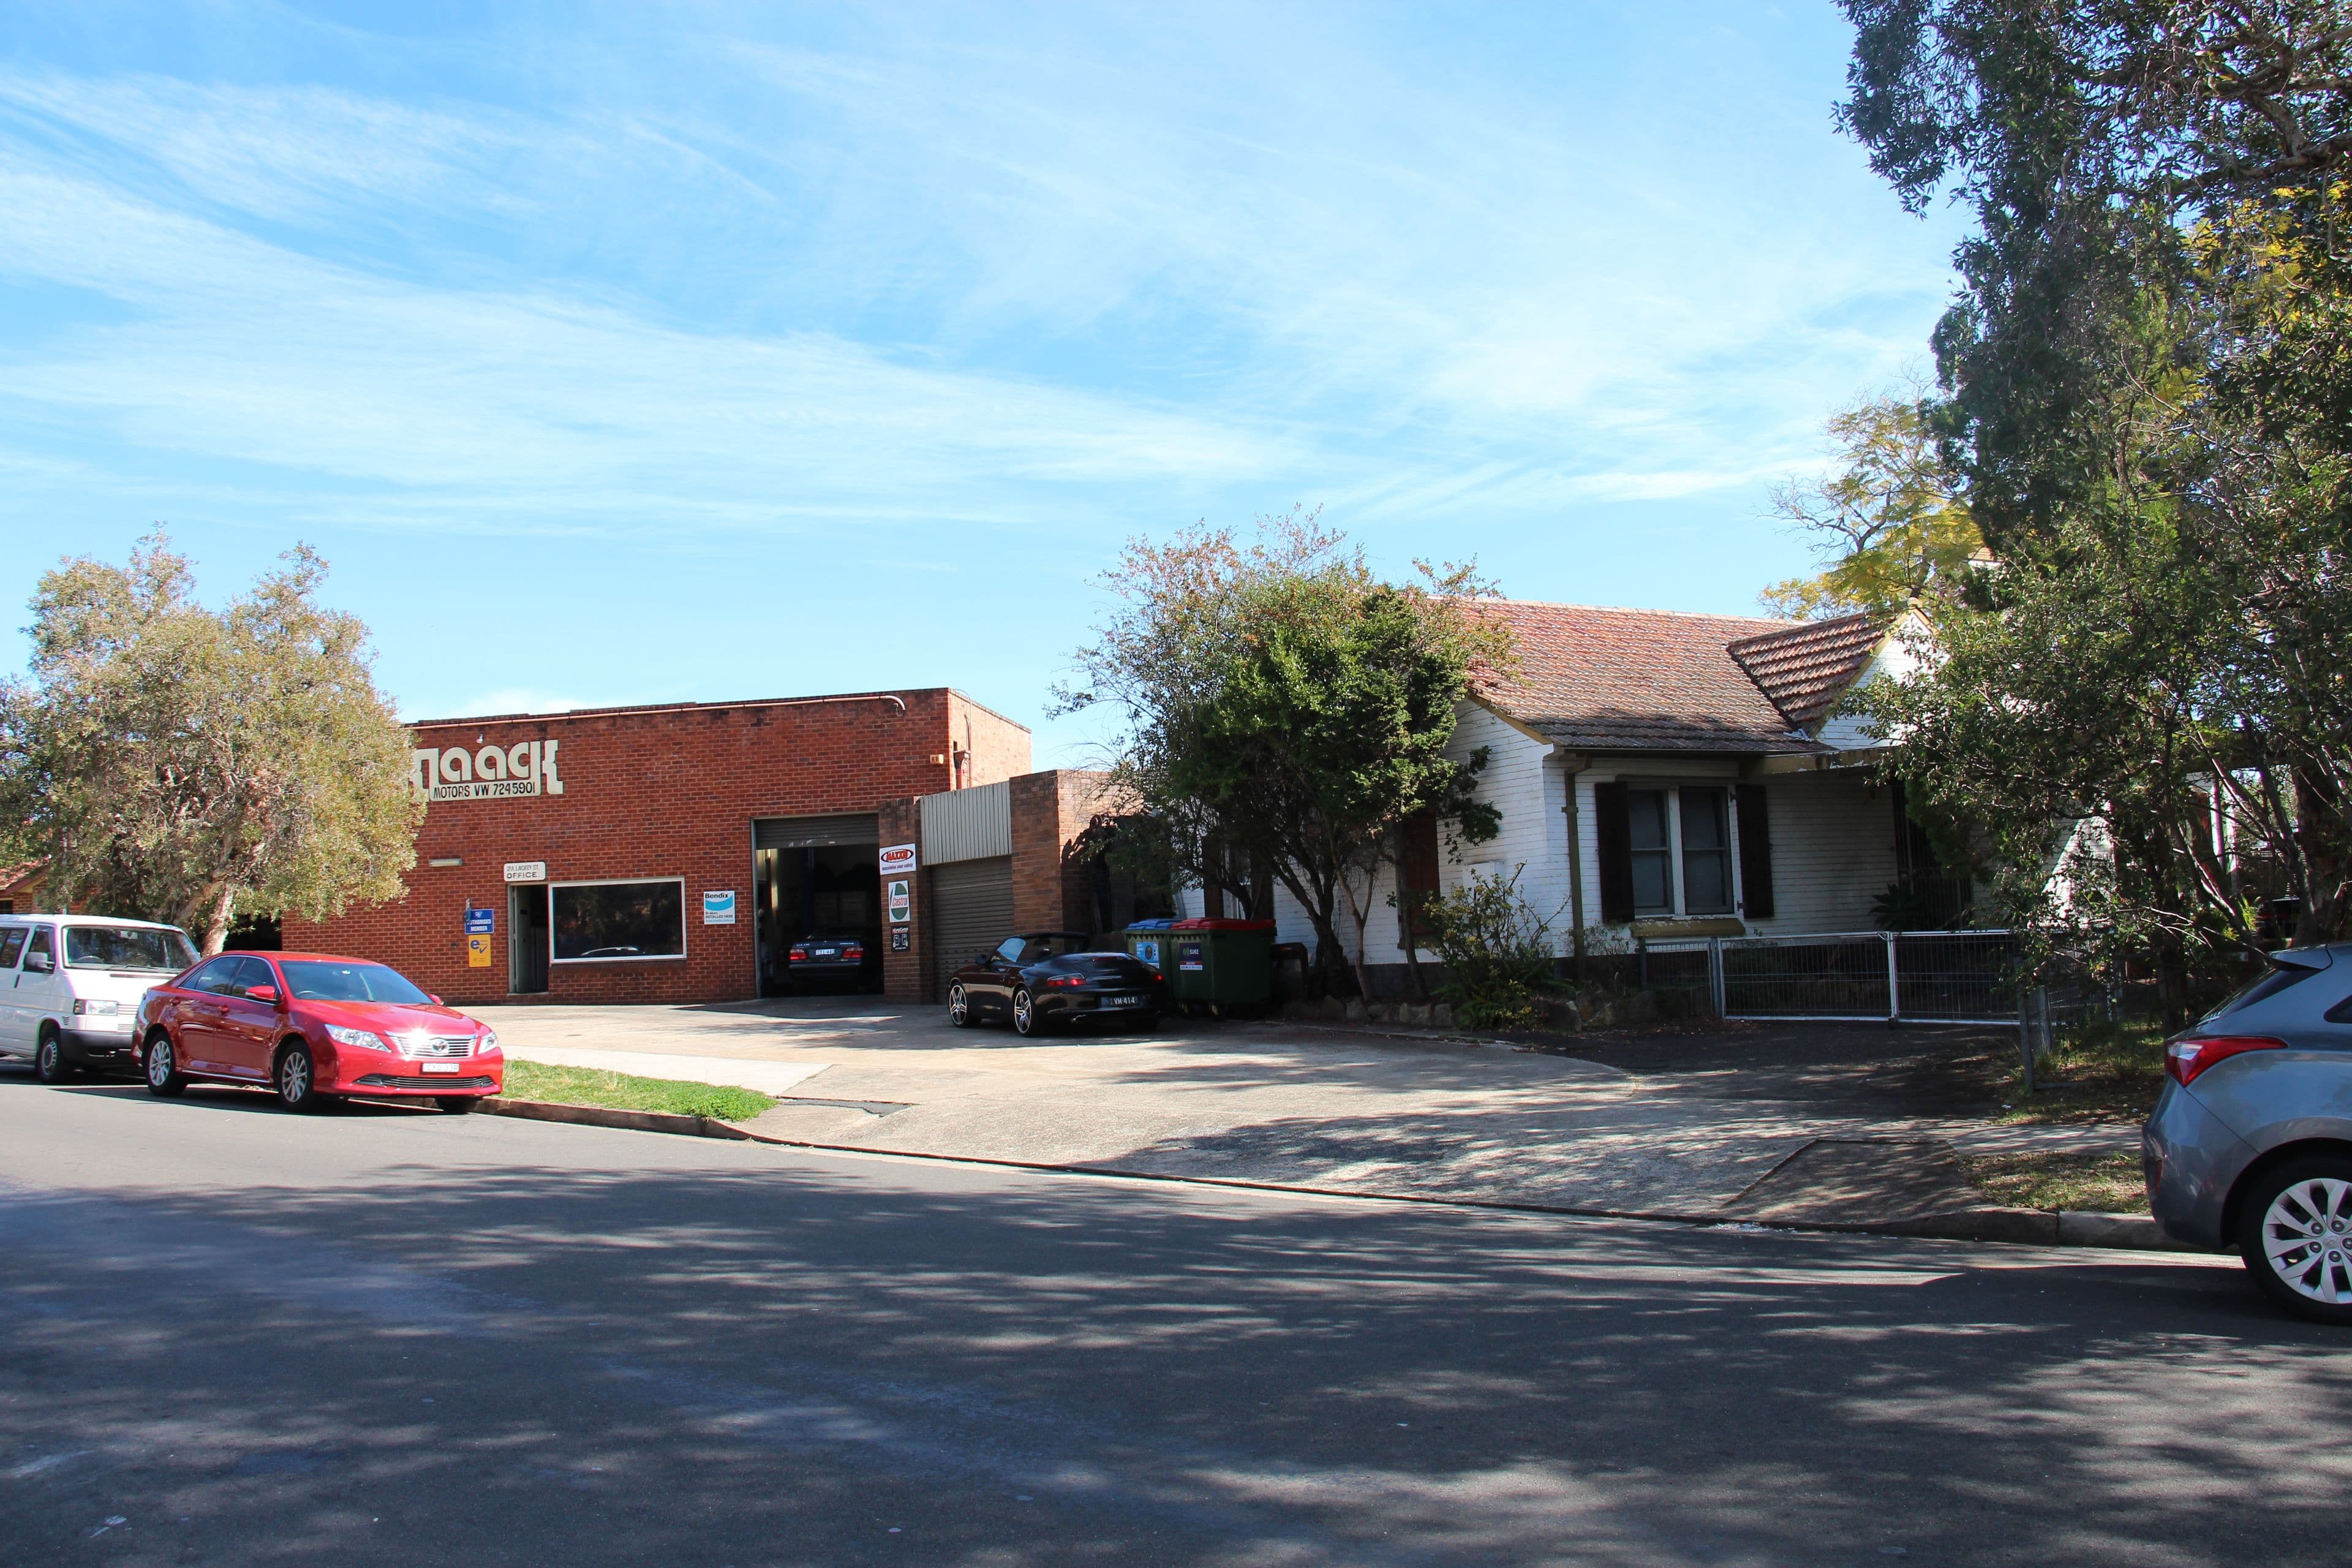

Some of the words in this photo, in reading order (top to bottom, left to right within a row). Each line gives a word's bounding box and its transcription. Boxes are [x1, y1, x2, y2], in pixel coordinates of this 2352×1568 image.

[433, 786, 470, 799] MOTORS
[474, 785, 489, 796] VW
[892, 896, 908, 907] Castrol
